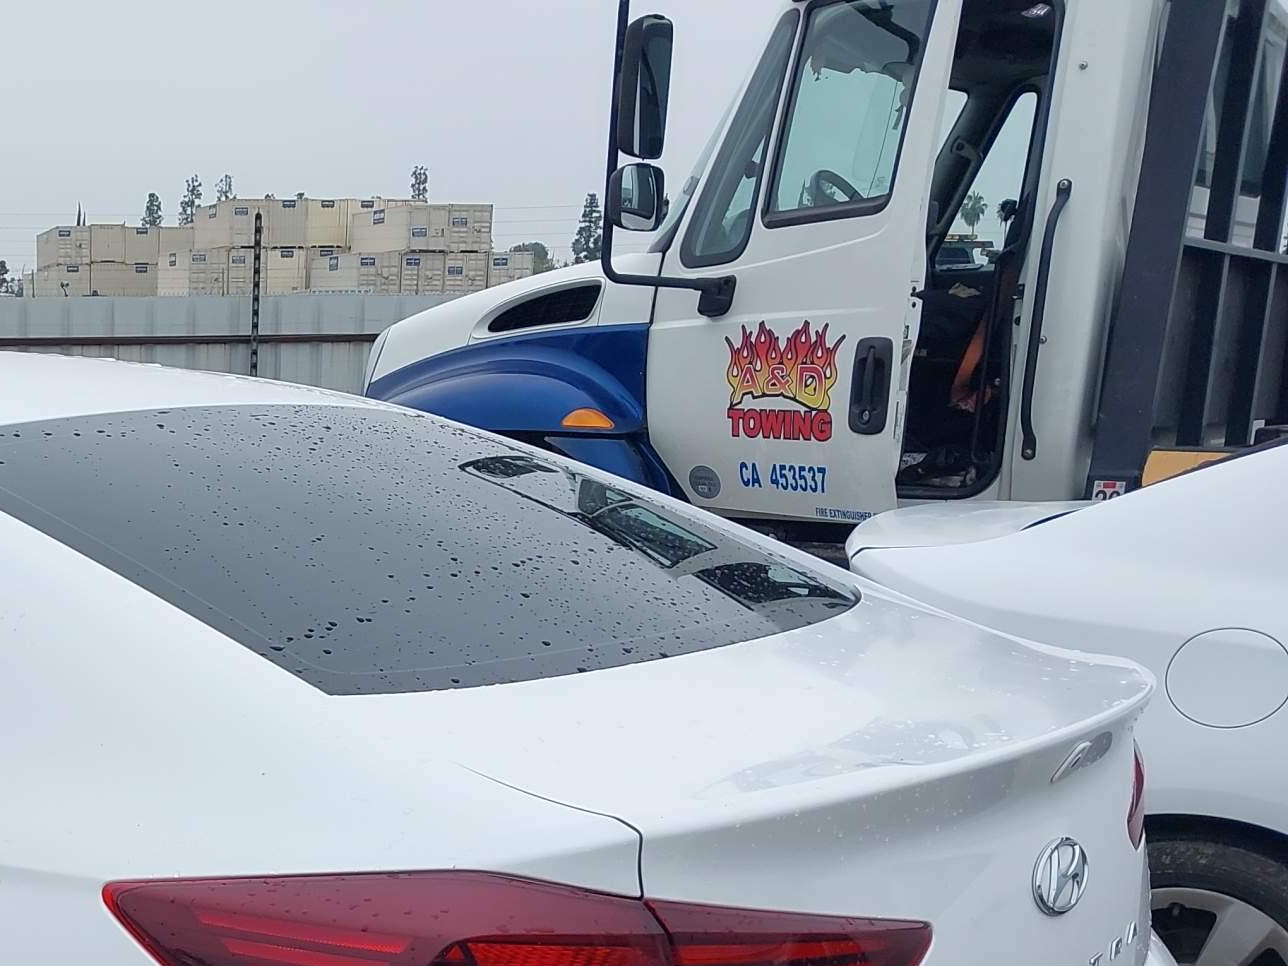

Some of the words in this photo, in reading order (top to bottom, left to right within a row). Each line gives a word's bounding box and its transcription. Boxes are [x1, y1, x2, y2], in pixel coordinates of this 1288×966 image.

[727, 407, 832, 441] TOWING
[739, 461, 763, 488] CA
[769, 463, 827, 494] 453537
[815, 506, 829, 518] FIRE
